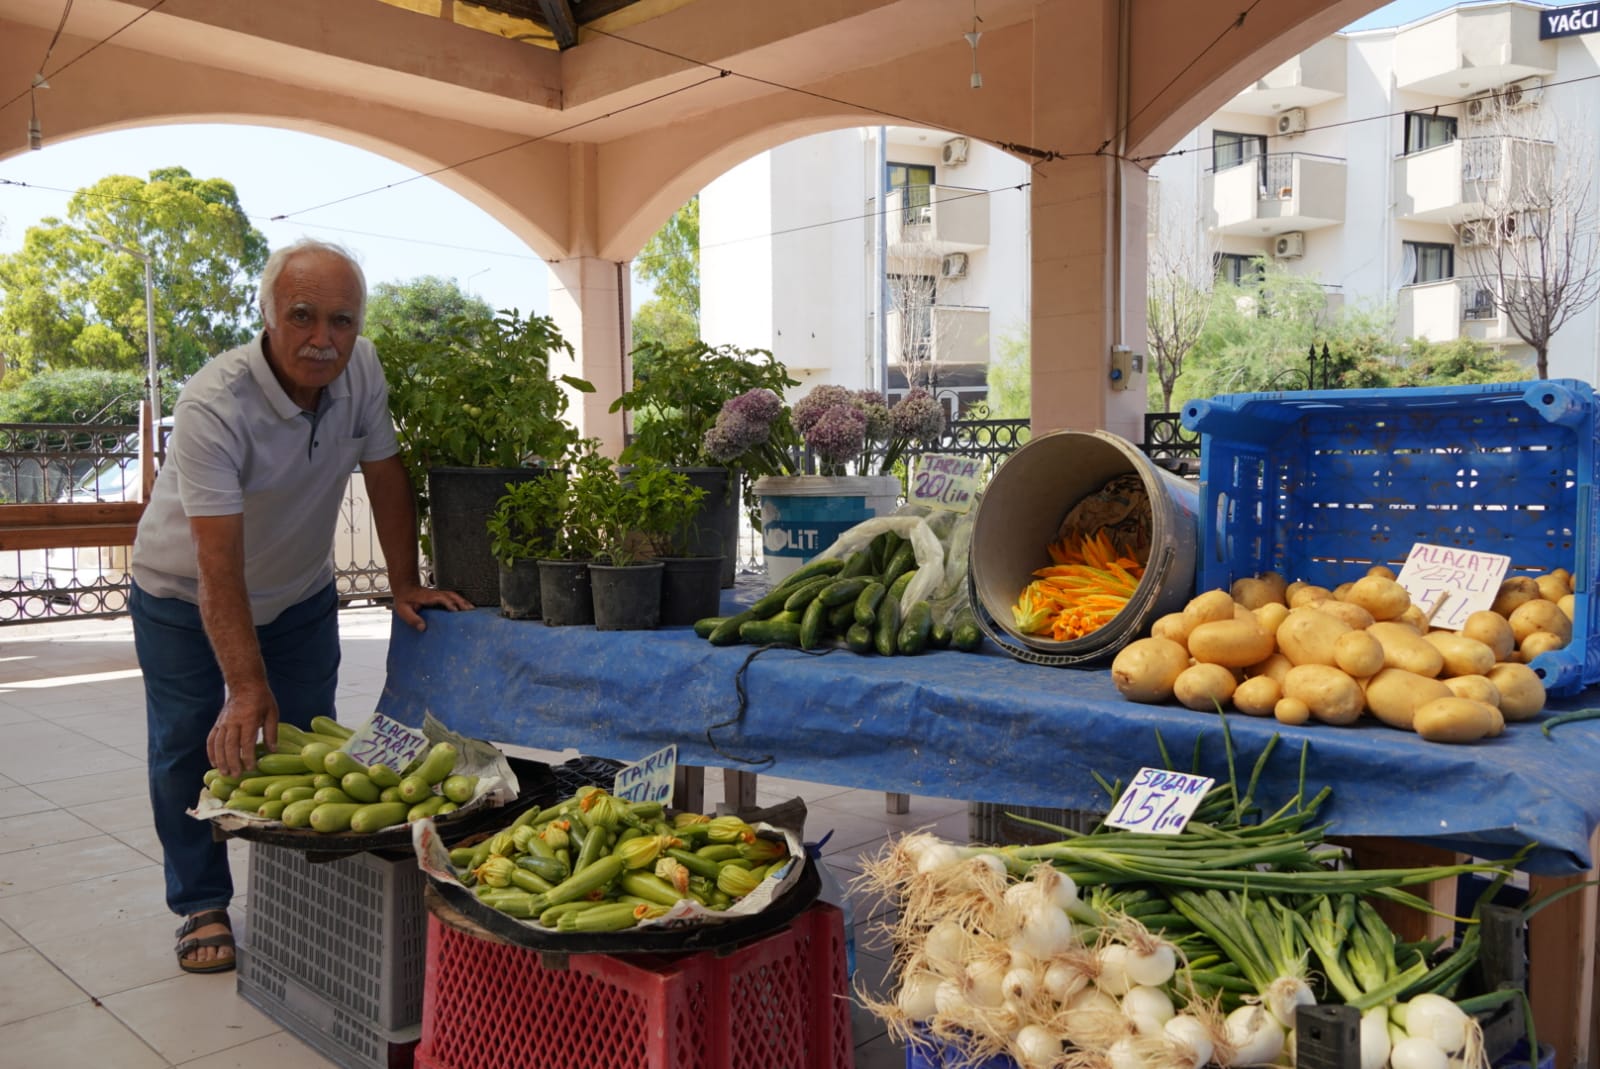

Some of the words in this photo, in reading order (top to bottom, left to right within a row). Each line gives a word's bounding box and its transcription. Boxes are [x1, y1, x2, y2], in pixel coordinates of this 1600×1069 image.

[1548, 9, 1598, 33] YAĞCI
[916, 472, 946, 497] 20
[1114, 788, 1166, 825] 15
